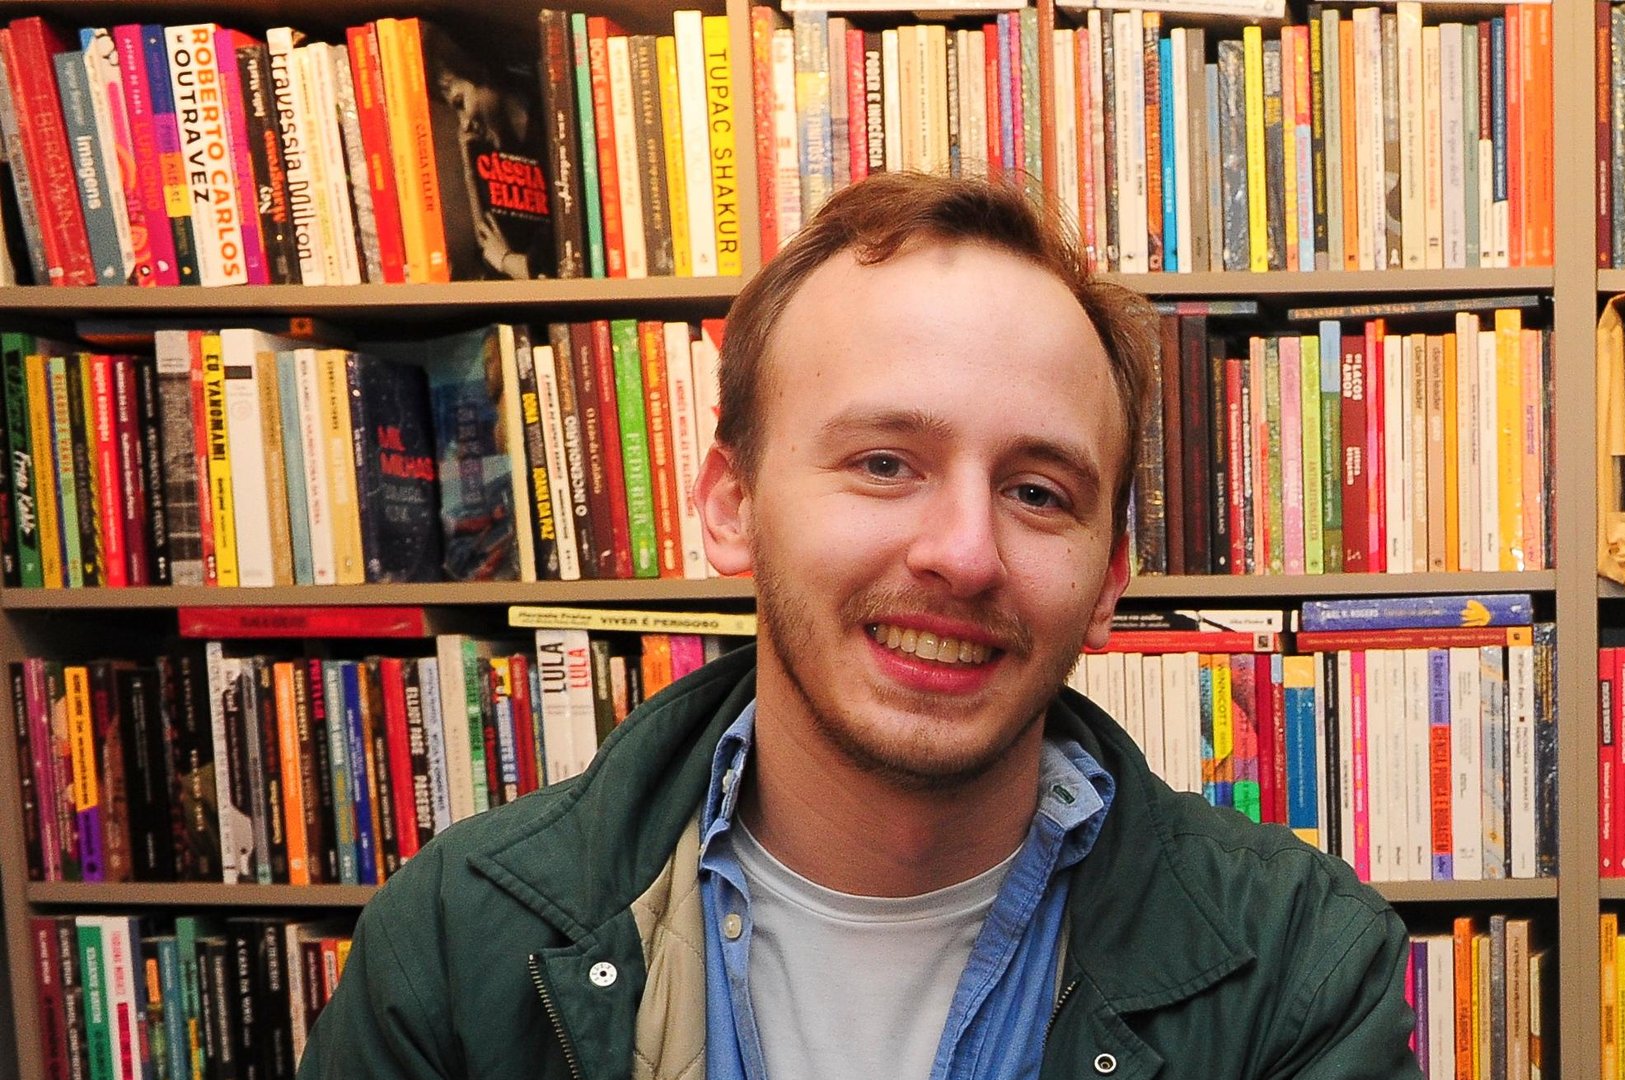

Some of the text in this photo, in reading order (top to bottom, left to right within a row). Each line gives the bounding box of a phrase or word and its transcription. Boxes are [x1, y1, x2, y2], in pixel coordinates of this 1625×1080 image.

[175, 50, 210, 204] OUTRA VEZ
[191, 28, 240, 277] ROBERTO CARLOS
[708, 48, 738, 254] TUPAC SHAKUR
[76, 136, 103, 210] Imagens
[490, 183, 549, 216] ELLER
[205, 354, 225, 461] EU YANOMAMI
[1415, 379, 1424, 409] leader
[1431, 346, 1442, 410] darian leader
[627, 432, 649, 527] FEDERER
[540, 641, 567, 694] LULA
[568, 647, 591, 689] LULA
